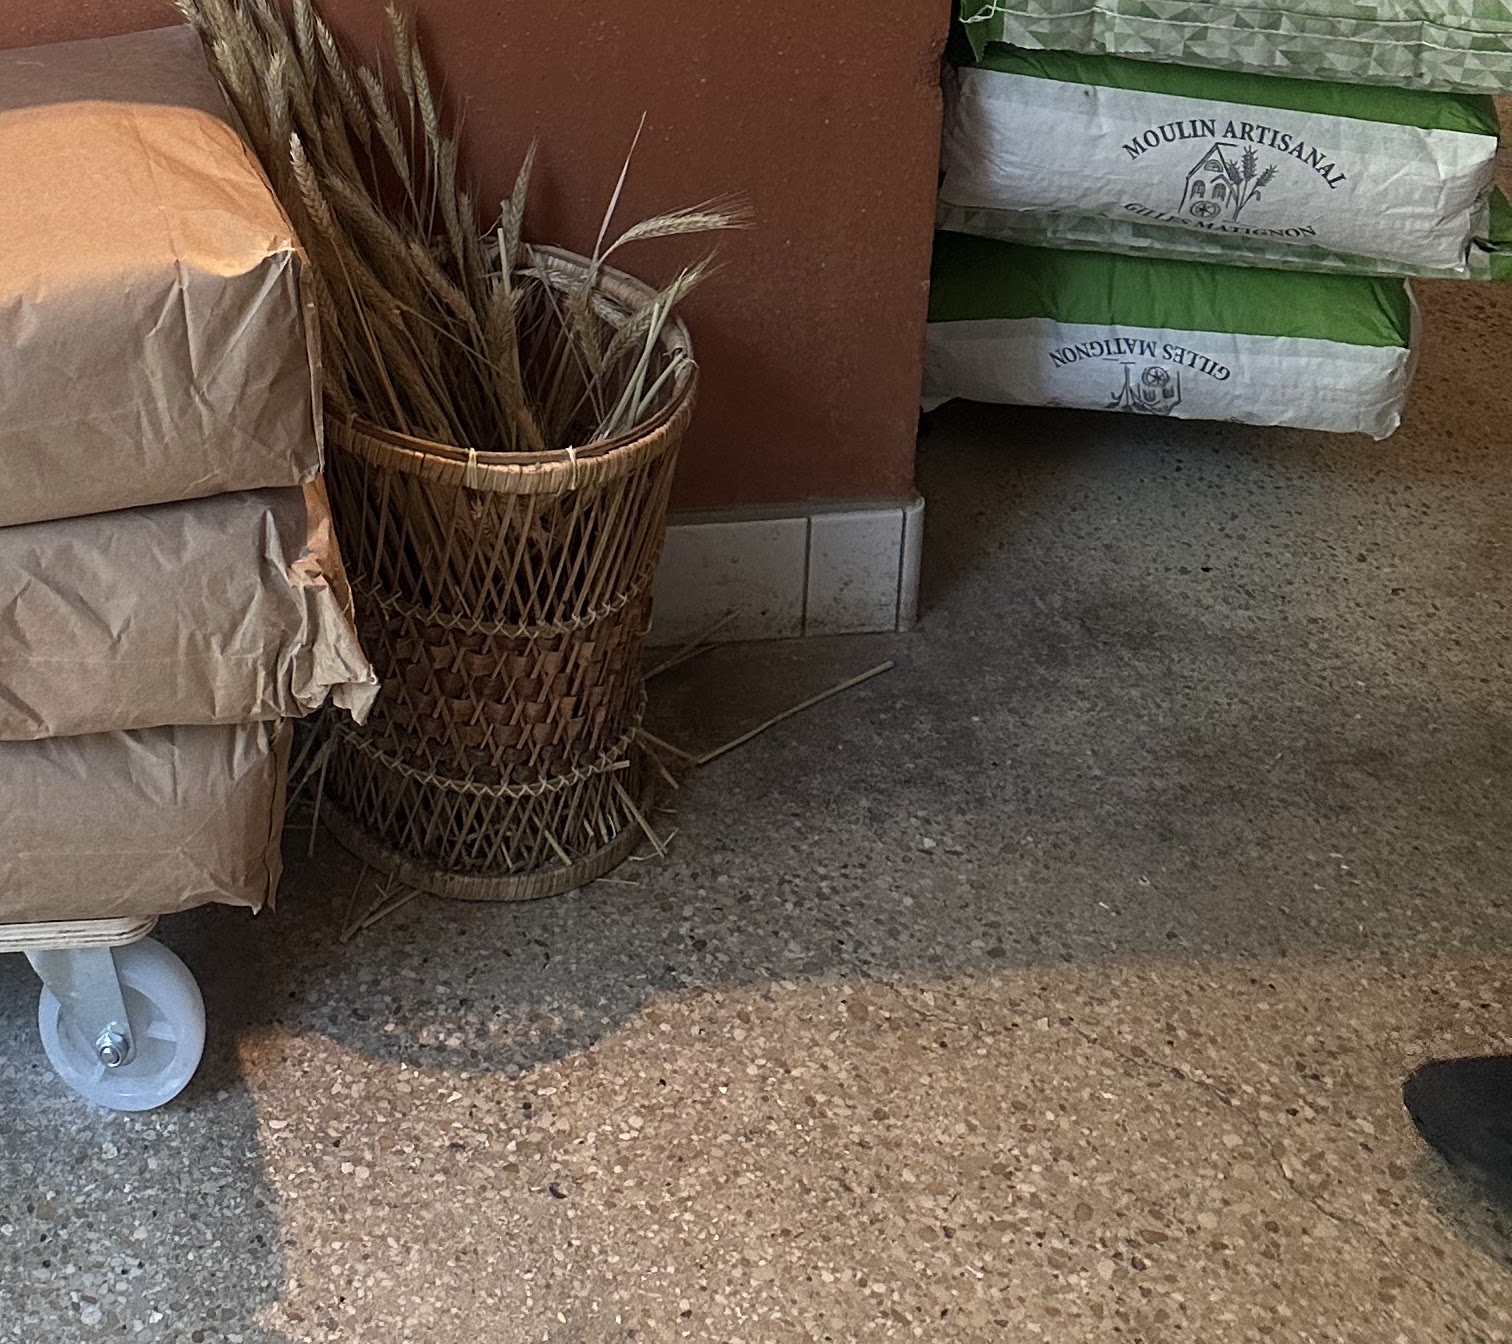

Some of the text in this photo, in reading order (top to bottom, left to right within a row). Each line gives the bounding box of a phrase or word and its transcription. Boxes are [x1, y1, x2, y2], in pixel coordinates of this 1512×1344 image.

[1121, 118, 1348, 190] MOULIN ARTISANAL
[1193, 220, 1318, 238] MATIGNON
[1048, 338, 1232, 382] GILLES MATIGNON
